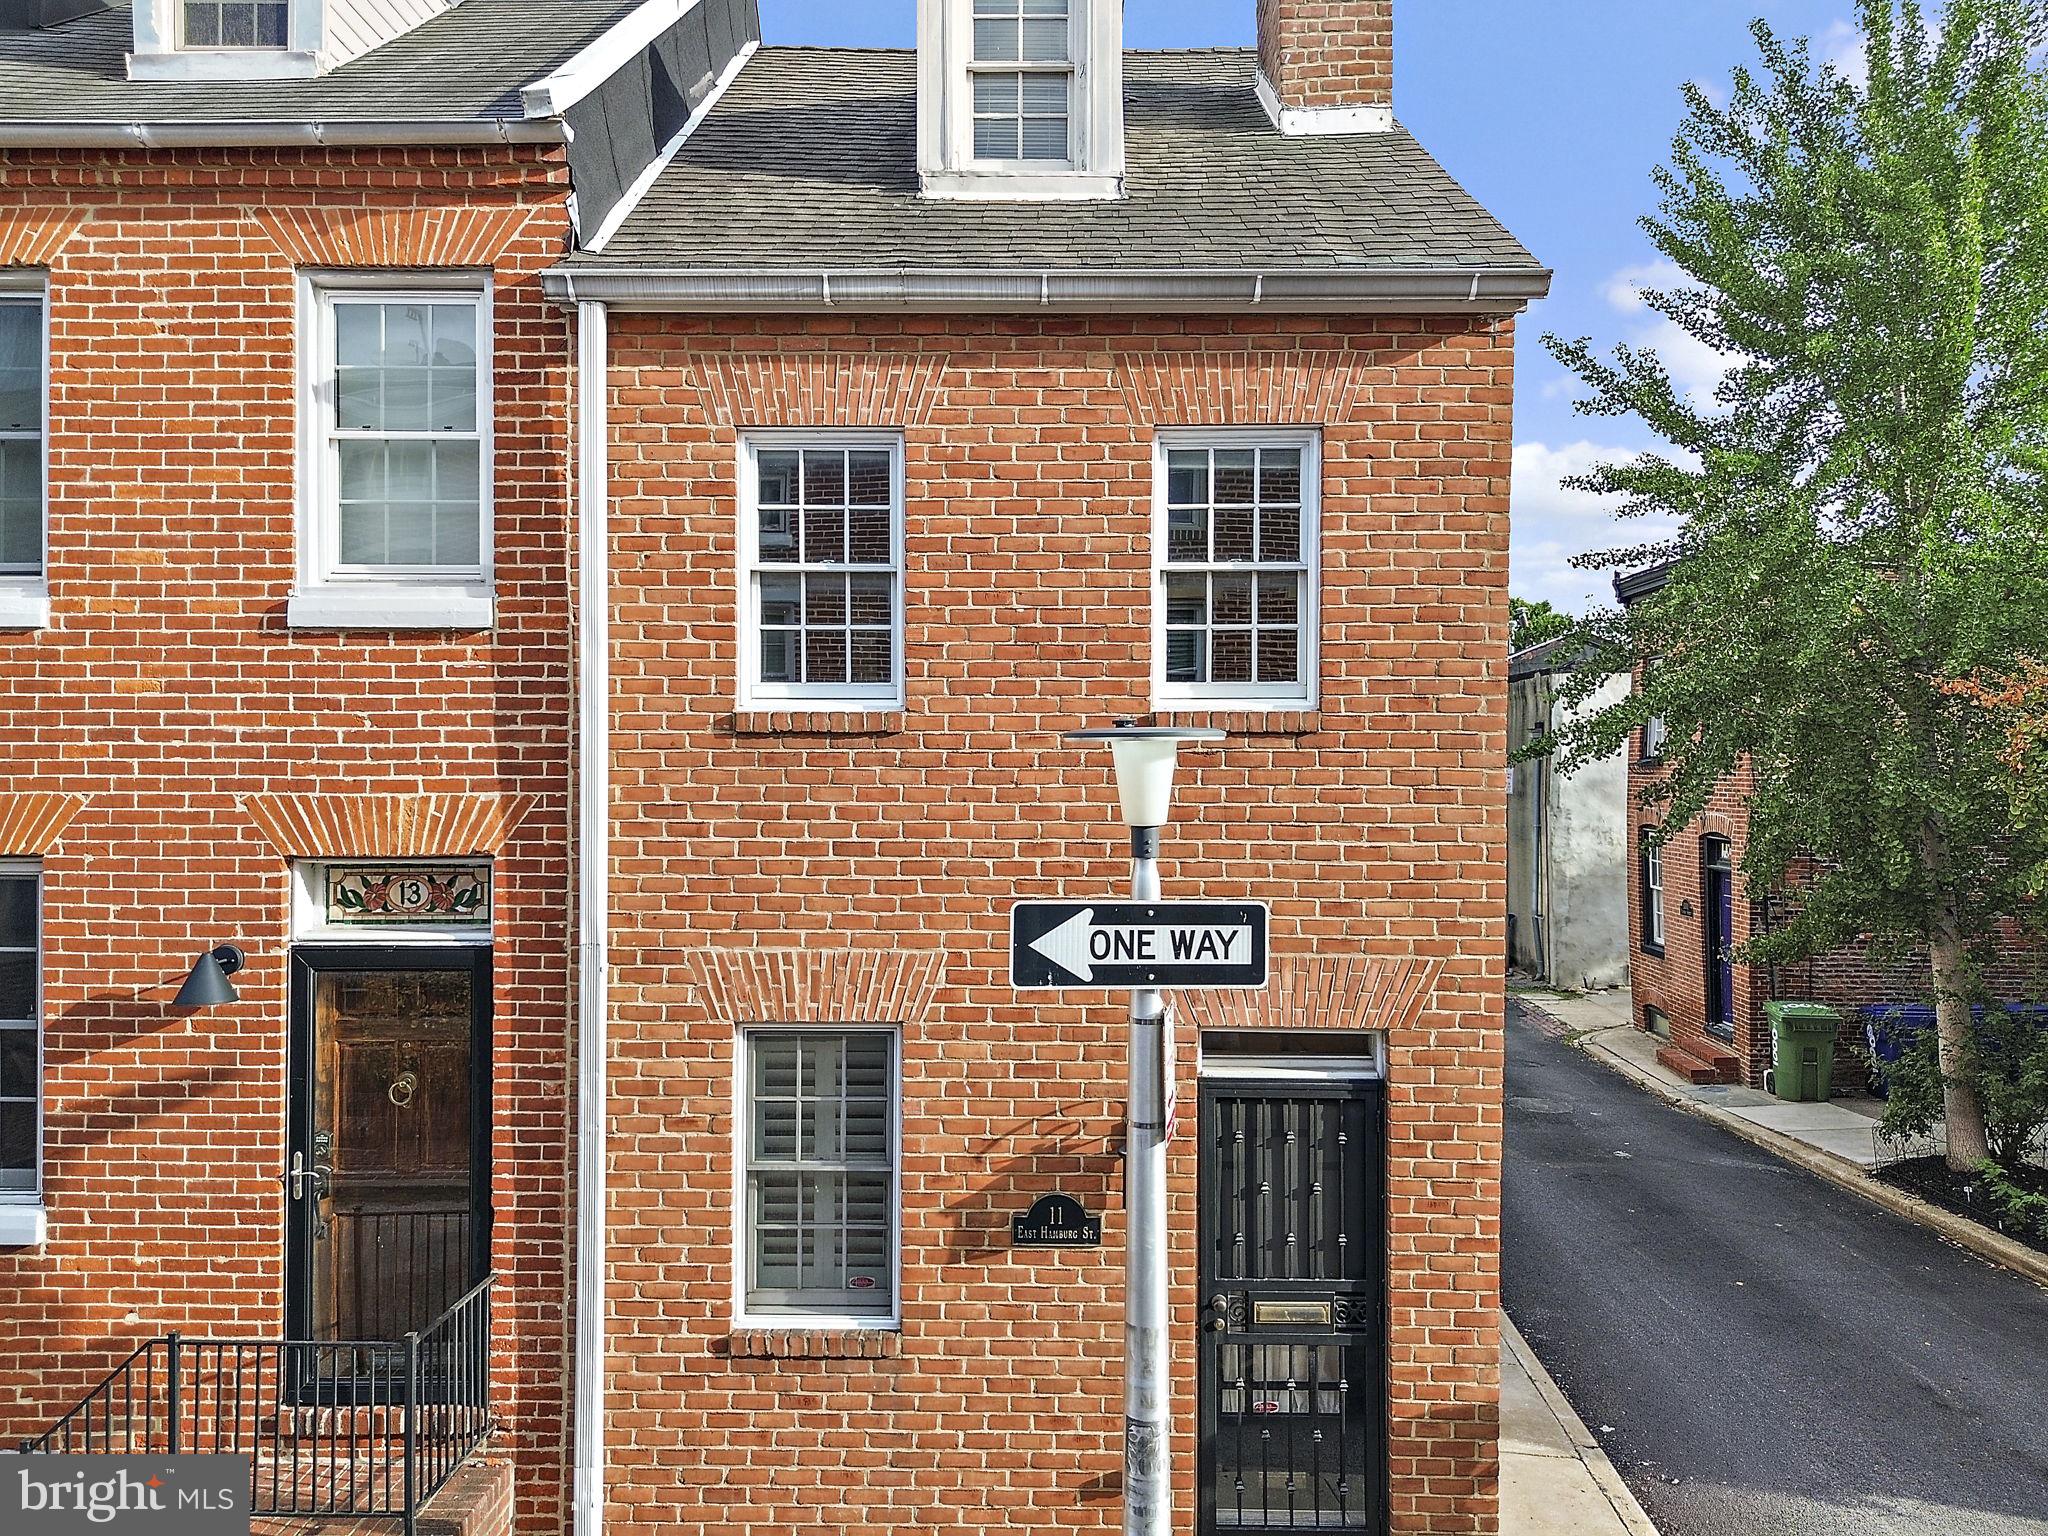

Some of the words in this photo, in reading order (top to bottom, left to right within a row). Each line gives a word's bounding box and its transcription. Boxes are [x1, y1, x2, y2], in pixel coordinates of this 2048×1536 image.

[399, 880, 421, 905] 13
[1090, 929, 1155, 960] ONE
[1170, 929, 1239, 960] WAY
[1049, 1206, 1063, 1225] 11
